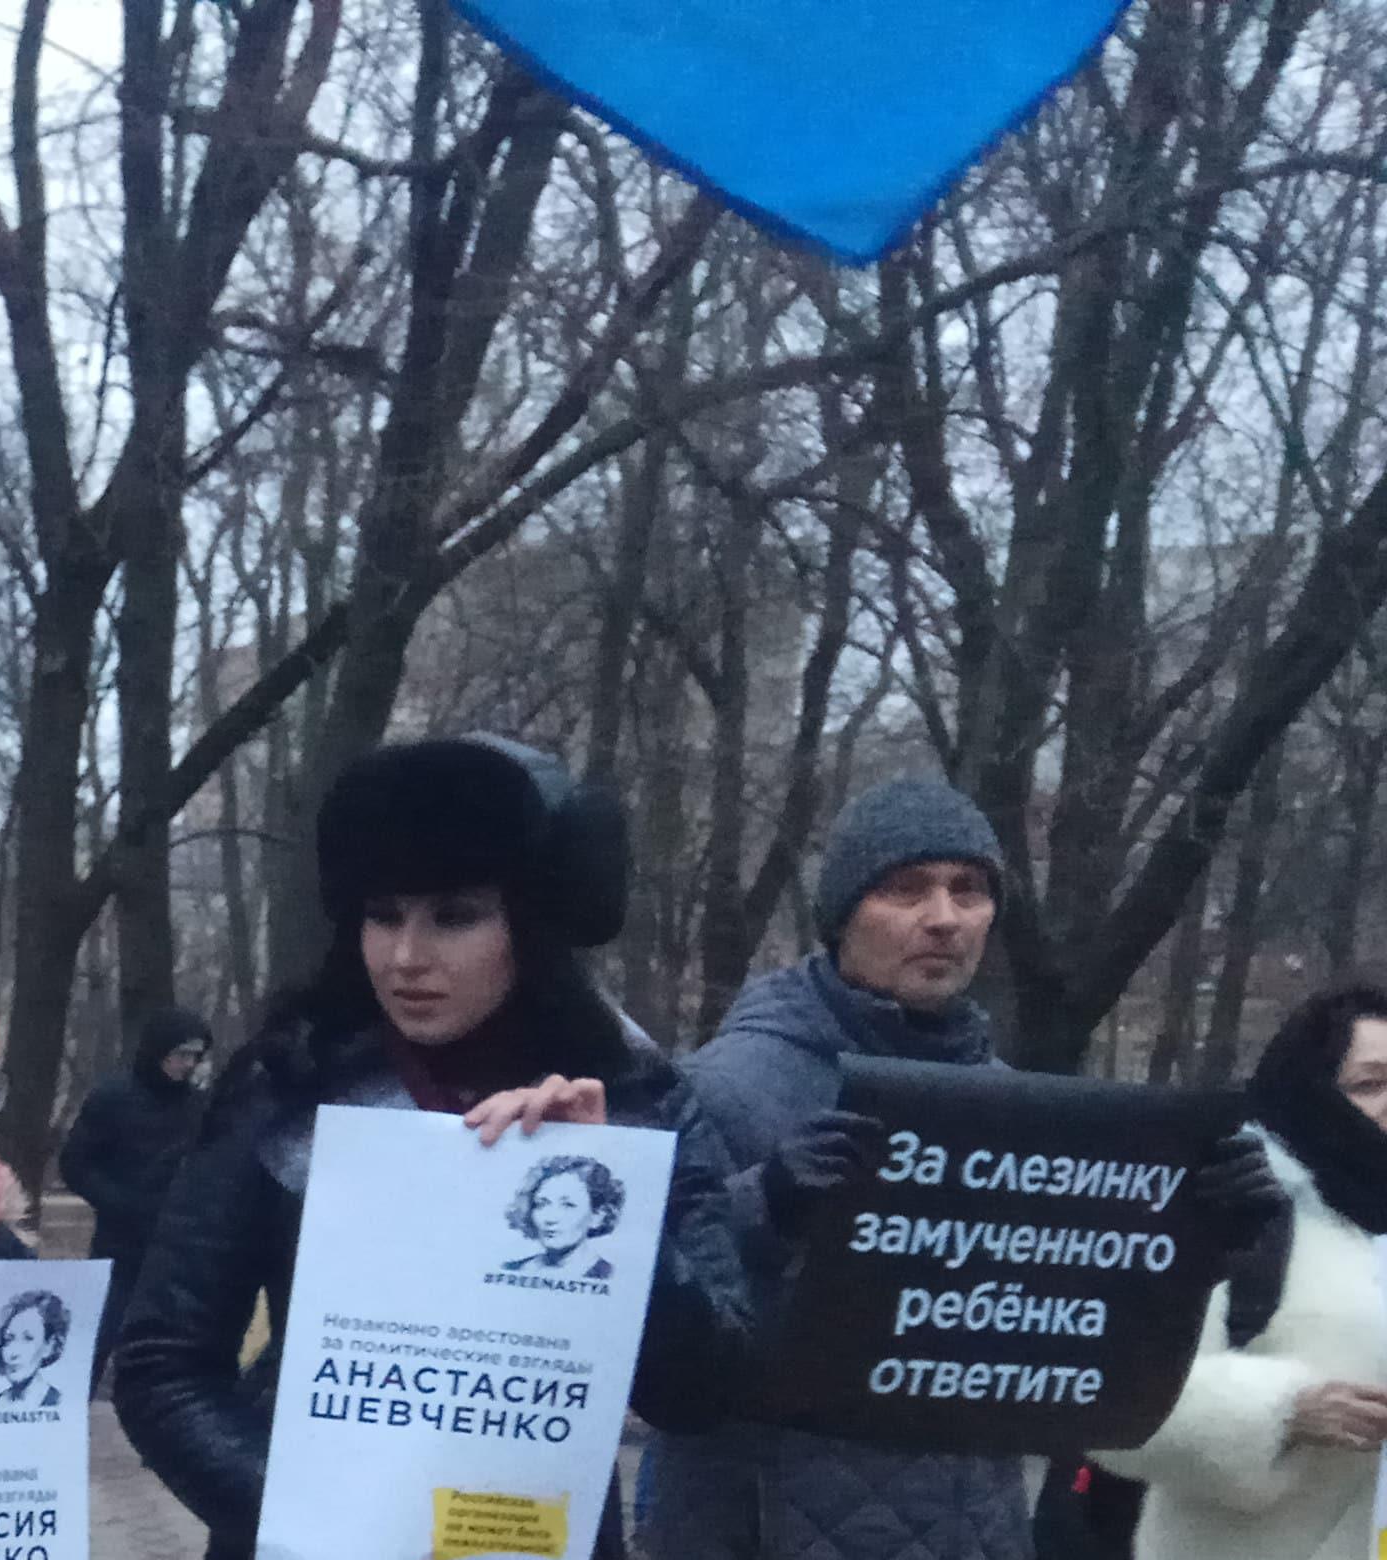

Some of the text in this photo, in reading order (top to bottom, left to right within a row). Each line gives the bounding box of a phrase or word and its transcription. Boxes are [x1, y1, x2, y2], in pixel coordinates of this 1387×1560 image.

[876, 1130, 1187, 1212] За слезинку
[849, 1212, 1177, 1272] замученного
[483, 1273, 611, 1296] #FREENASTYA
[893, 1281, 1107, 1337] ребёнка
[321, 1335, 594, 1375] за политические взгляды
[323, 1312, 571, 1351] Незаконно арестована
[312, 1357, 590, 1410] АНАСТАСИЯ
[869, 1357, 1104, 1404] ответите
[309, 1390, 572, 1443] ШЕВЧЕНКО
